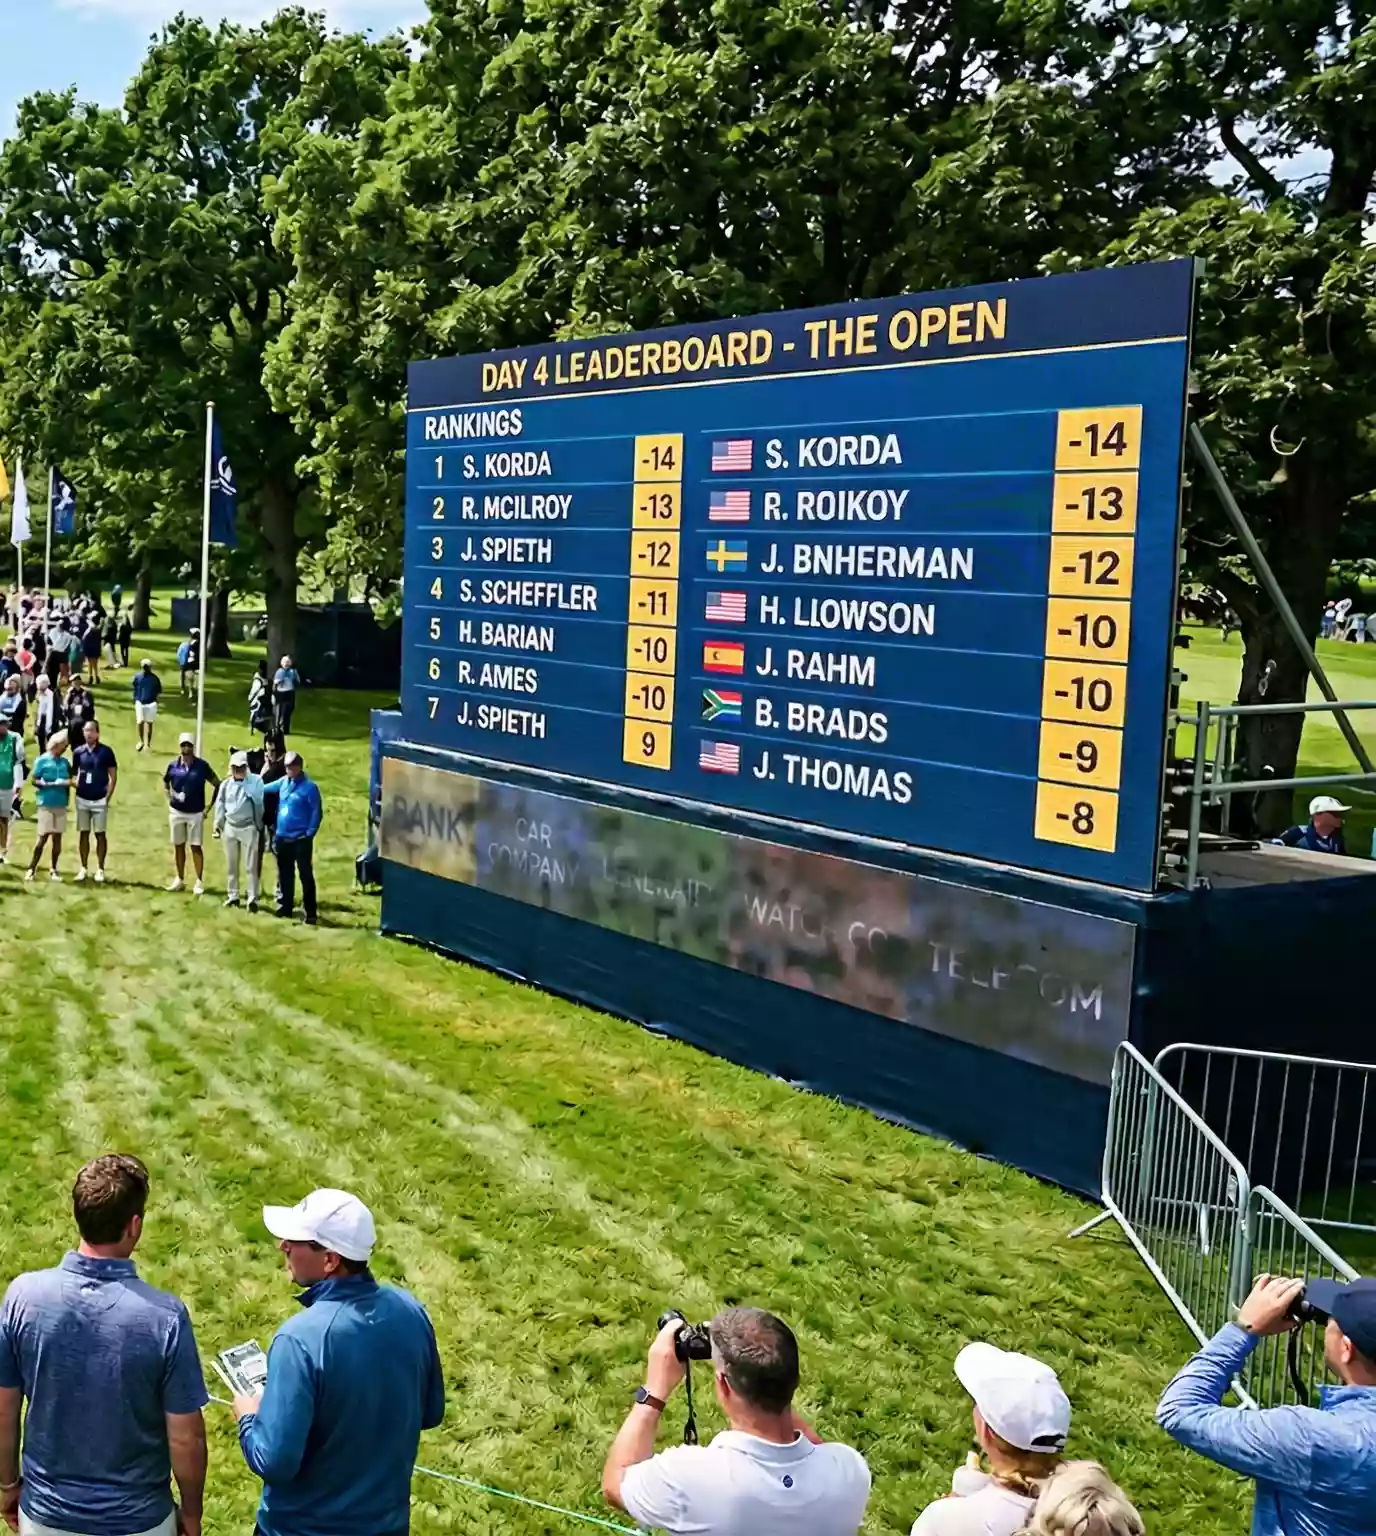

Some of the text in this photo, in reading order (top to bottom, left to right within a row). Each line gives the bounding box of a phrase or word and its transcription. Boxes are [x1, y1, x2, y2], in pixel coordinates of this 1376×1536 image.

[482, 298, 1007, 392] DAY 4 LEADERBOARD - THE OPEN
[425, 408, 523, 440] RANKINGS
[765, 421, 1128, 469] S. KORDA -14
[435, 445, 676, 479] 1 S. KORDA -14
[432, 493, 673, 520] 2 R. MCILROY -13
[764, 486, 1123, 521] R. ROIKOY -13
[431, 536, 672, 568] 3 J. SPIETH -12
[760, 543, 1120, 586] J. BNHERMAN -12
[430, 577, 667, 616] 4 S. SCHEFFLER -11
[430, 617, 668, 664] 5 H. BARIAN -10
[760, 595, 786, 625] H.
[1057, 613, 1117, 649] -10
[429, 657, 666, 711] 6 R. AMES -10
[756, 647, 1113, 712] J. RAHM -10
[428, 696, 656, 757] 7 J. SPIETH 9
[755, 698, 1098, 774] B. BRADS -9
[752, 751, 1094, 835] J. THOMAS -8
[515, 817, 553, 850] CAR
